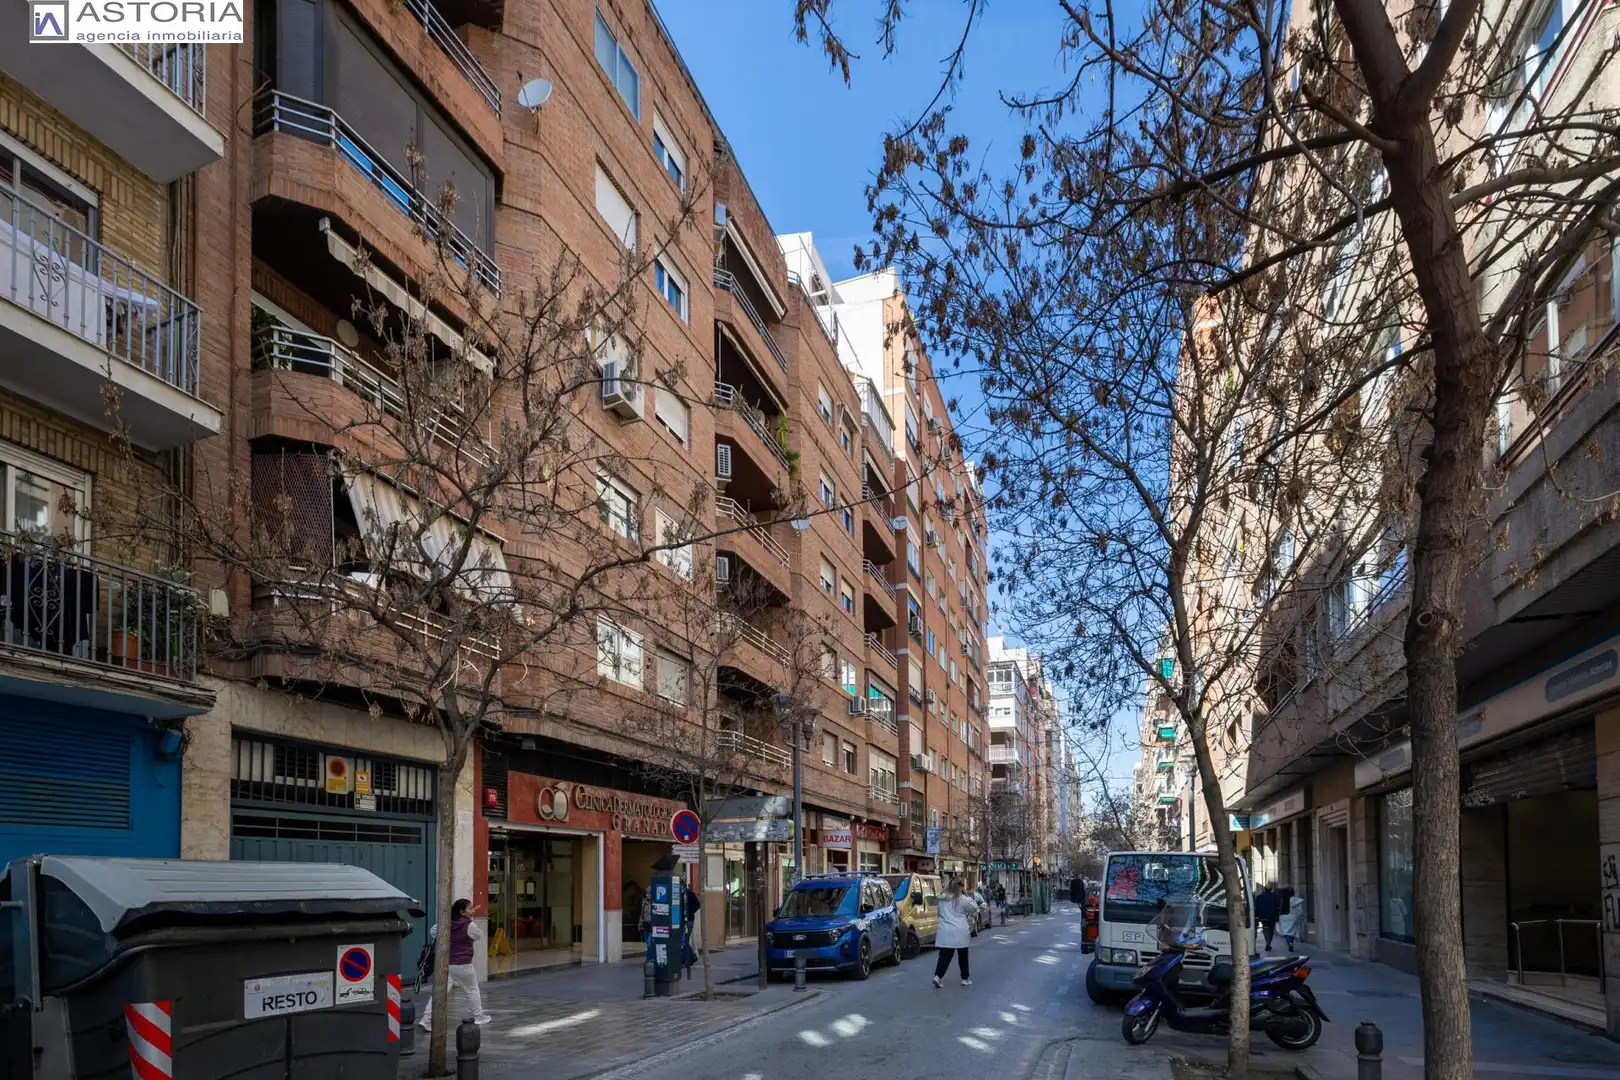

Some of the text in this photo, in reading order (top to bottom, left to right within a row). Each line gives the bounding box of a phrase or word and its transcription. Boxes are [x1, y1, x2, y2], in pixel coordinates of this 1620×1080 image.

[614, 813, 671, 834] GRANAD
[823, 835, 851, 843] BAZAR
[1125, 933, 1141, 941] SP
[262, 991, 317, 1011] RESTO
